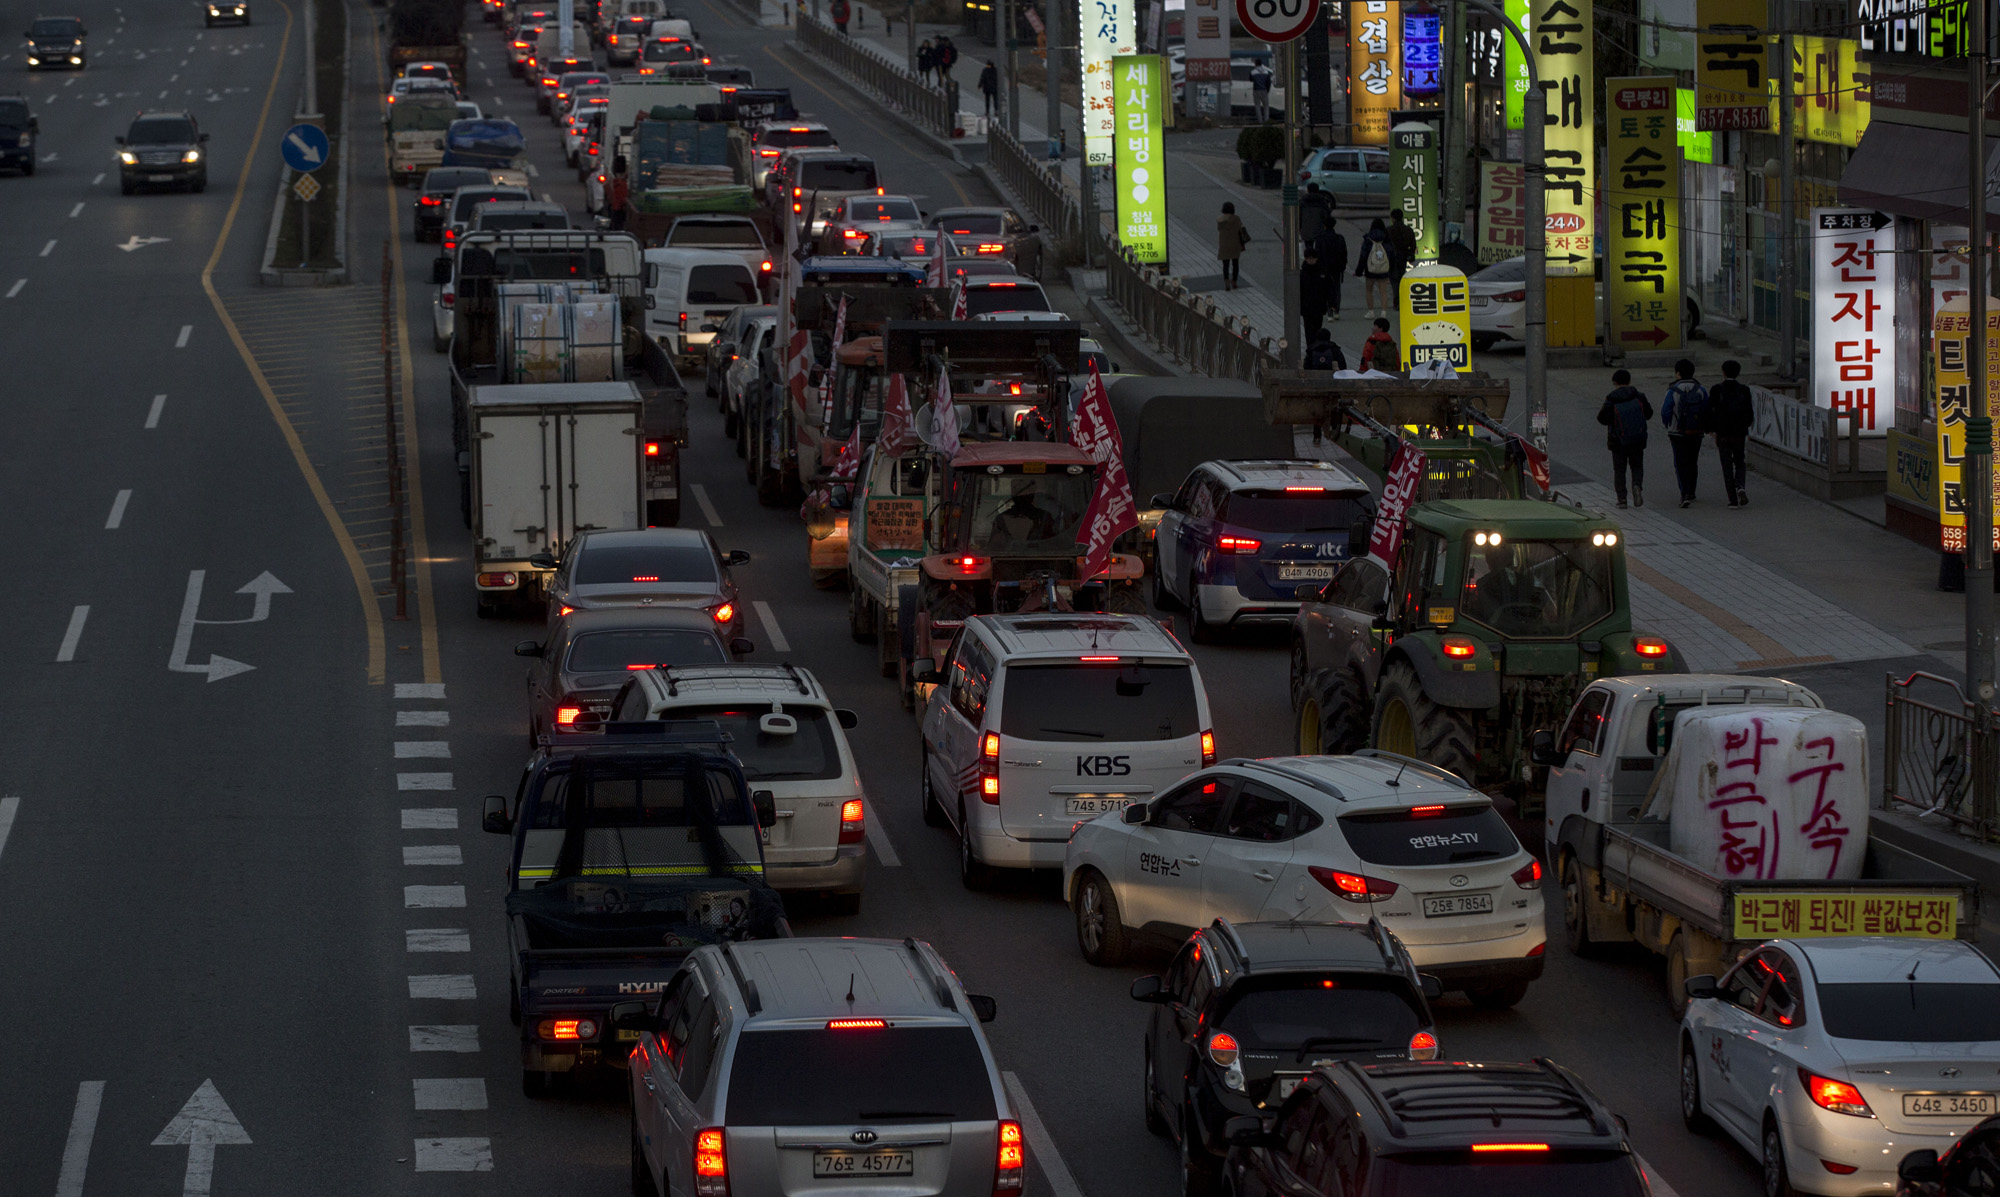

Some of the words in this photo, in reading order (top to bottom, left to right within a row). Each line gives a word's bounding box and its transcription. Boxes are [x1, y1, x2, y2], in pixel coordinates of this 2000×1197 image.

[1621, 89, 1667, 109] 무봉리
[1126, 63, 1150, 163] 세사리빙
[1699, 107, 1767, 129] 657-8550
[1618, 116, 1666, 139] 토종
[1402, 133, 1425, 148] 이불
[1402, 154, 1426, 241] 세사리빙
[1132, 212, 1152, 223] 침실
[1545, 216, 1579, 230] 24시
[1620, 146, 1668, 293] 순대국
[1823, 213, 1873, 229] 주차장
[1127, 225, 1158, 238] 전문점
[1409, 280, 1466, 316] 월드
[1622, 300, 1668, 322] 전문
[1832, 239, 1881, 431] 전자담배
[1316, 542, 1343, 557] jtbc
[1306, 568, 1329, 577] 4906
[1076, 755, 1131, 776] KBS
[1073, 800, 1095, 811] 74호
[1708, 717, 1780, 880] 박근혜
[1788, 736, 1850, 880] 구속
[1139, 852, 1181, 877] 연합뉴스
[1458, 897, 1486, 911] 7854
[1741, 898, 1800, 933] 박근혜
[1809, 898, 1855, 933] 퇴진!
[1912, 1098, 1942, 1113] 64호
[1949, 1097, 1988, 1112] 3450
[854, 1131, 876, 1142] KIA
[822, 1154, 854, 1171] 76모
[862, 1154, 903, 1171] 4577
